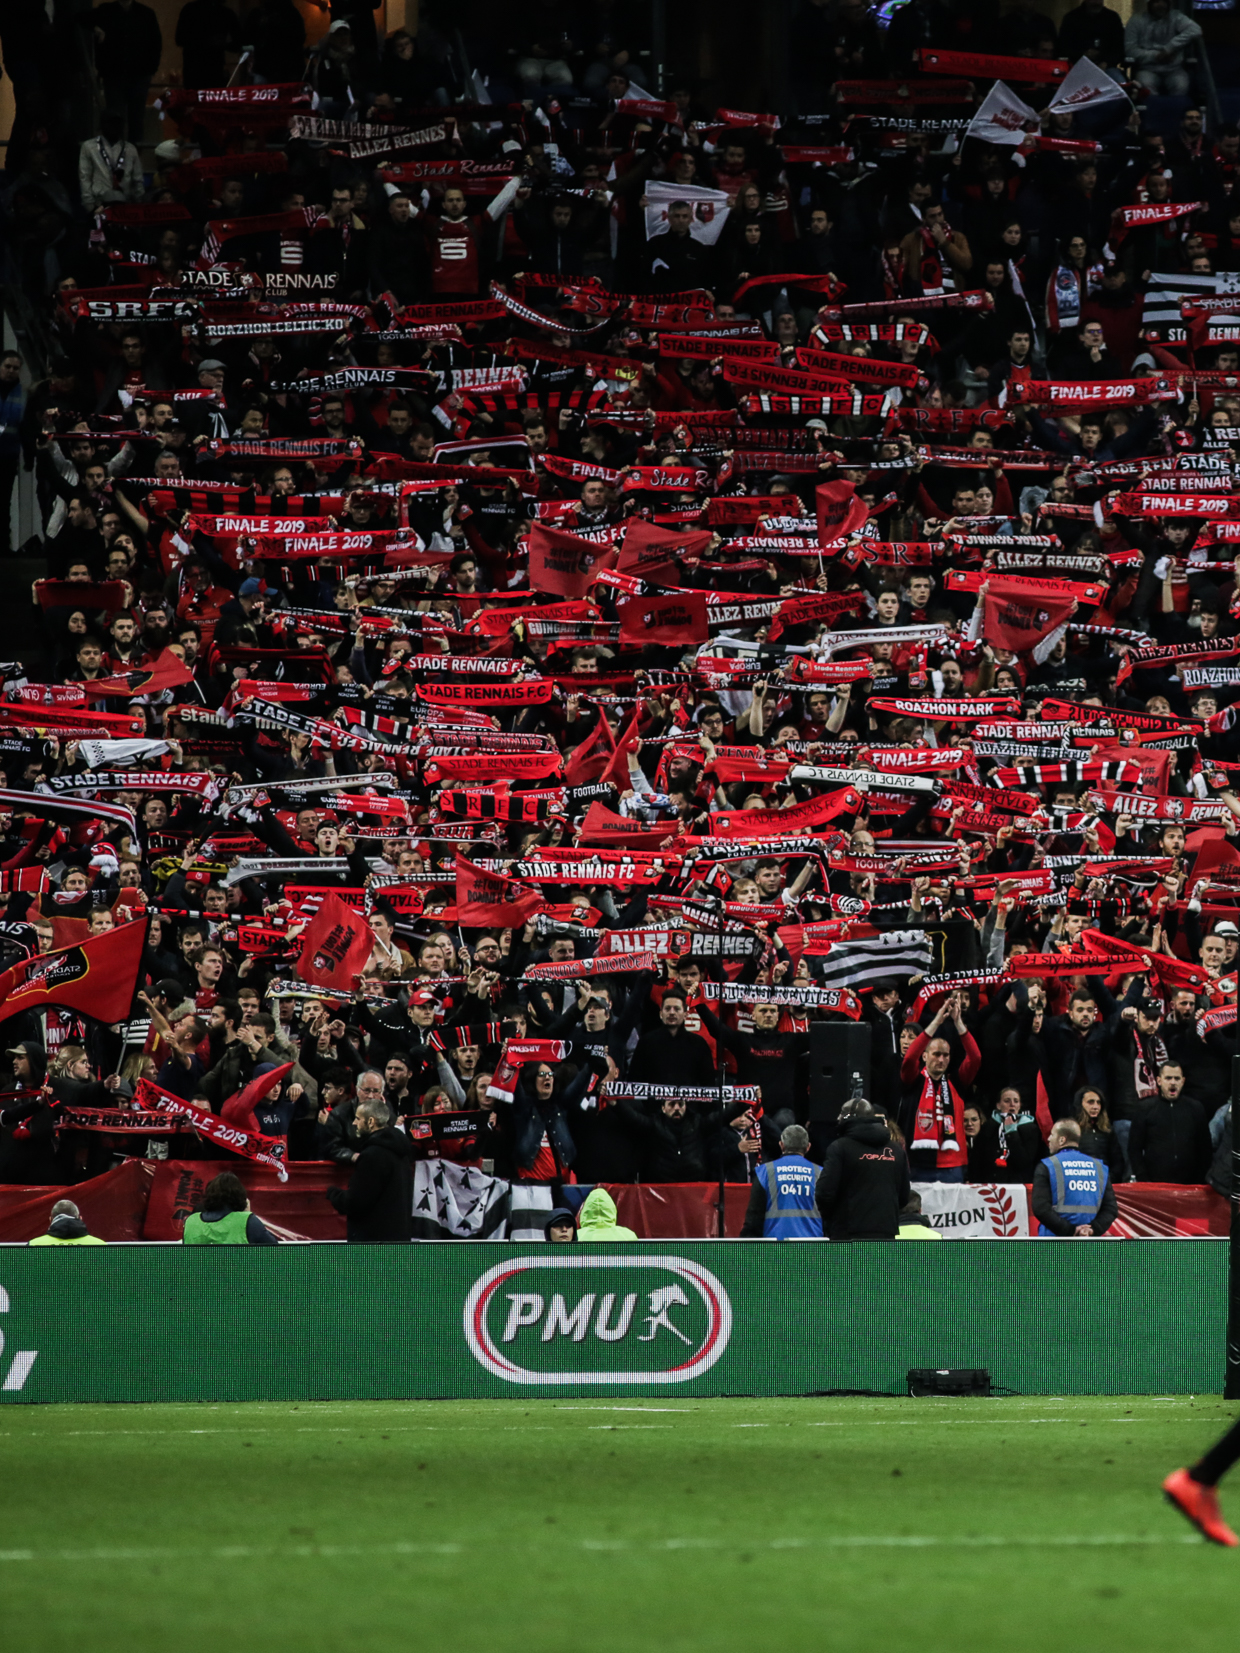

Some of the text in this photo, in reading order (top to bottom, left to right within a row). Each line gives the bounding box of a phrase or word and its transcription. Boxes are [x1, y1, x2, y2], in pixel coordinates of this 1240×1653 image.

[197, 88, 278, 101] FINALE 2019
[349, 137, 395, 159] ALLEZ
[182, 271, 336, 289] STADE RENNAIS
[88, 301, 199, 318] SRFC
[663, 339, 702, 352] STADE
[325, 369, 395, 385] RENNAIS
[1051, 384, 1135, 399] FINALE 2019
[230, 442, 266, 455] STADE
[321, 441, 337, 454] FC
[1141, 476, 1232, 490] STADE RENNAIS
[1143, 497, 1228, 512] FINALE 2019
[216, 518, 304, 534] FINALE 2019
[285, 534, 372, 551] FINALE 2019
[997, 552, 1040, 568] ALLEZ
[410, 656, 506, 673] STADE RENNAIS
[419, 685, 523, 699] STADE RENNAIS
[896, 701, 994, 715] ROAZHON PARK
[873, 750, 962, 765] FINALE 2019
[50, 772, 201, 789] STADE RENNAIS
[1113, 800, 1158, 816] ALLEZ
[520, 864, 634, 878] STADE RENNAIS FC
[610, 933, 754, 954] ALLEZ RENNES
[704, 983, 839, 1006] ULTRAS RENNES
[157, 1097, 248, 1147] FINALE 2019
[449, 1119, 470, 1127] STADE
[1064, 1169, 1095, 1177] SECURITY
[781, 1185, 810, 1196] 0411
[1069, 1180, 1096, 1192] 0603
[505, 1293, 637, 1343] PMU
